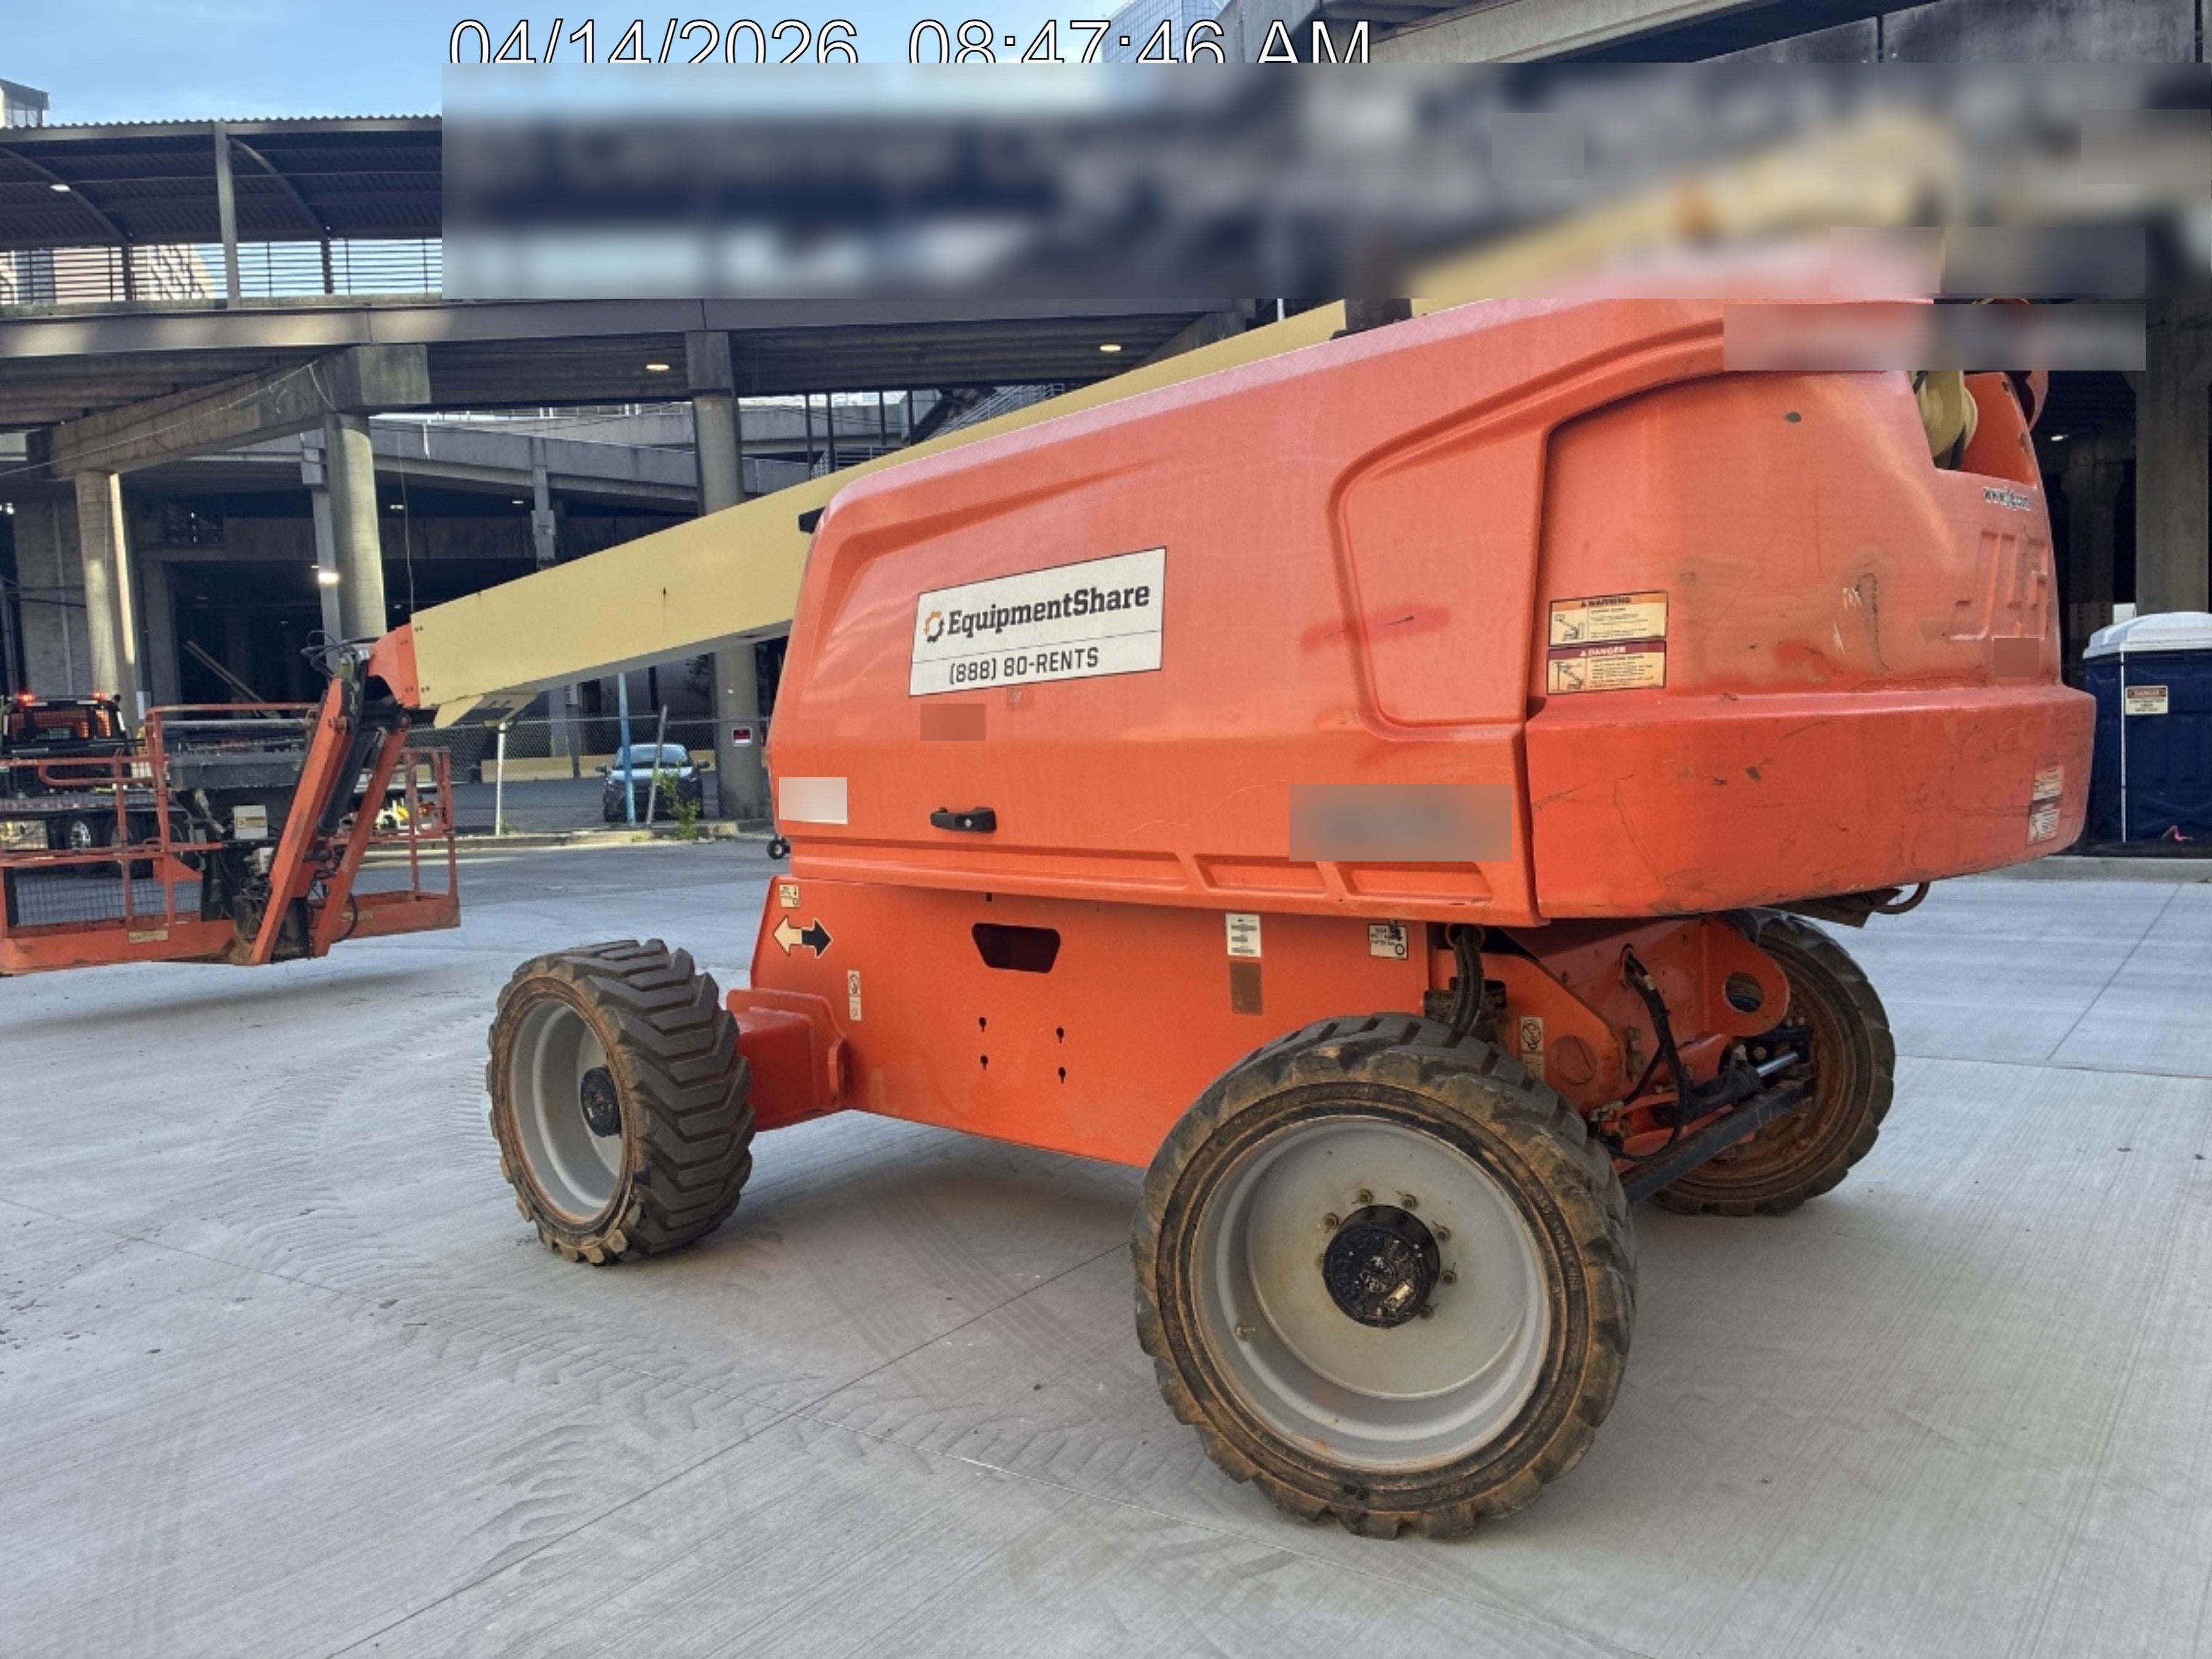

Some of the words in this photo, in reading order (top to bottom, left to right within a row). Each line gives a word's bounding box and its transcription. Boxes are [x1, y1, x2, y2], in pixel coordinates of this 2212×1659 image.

[947, 585, 1150, 638] EquipmentShare
[1588, 597, 1631, 607] WARNING
[1588, 646, 1626, 657] DANGER
[949, 658, 997, 685] (888)
[1004, 646, 1099, 678] 80-RENTS
